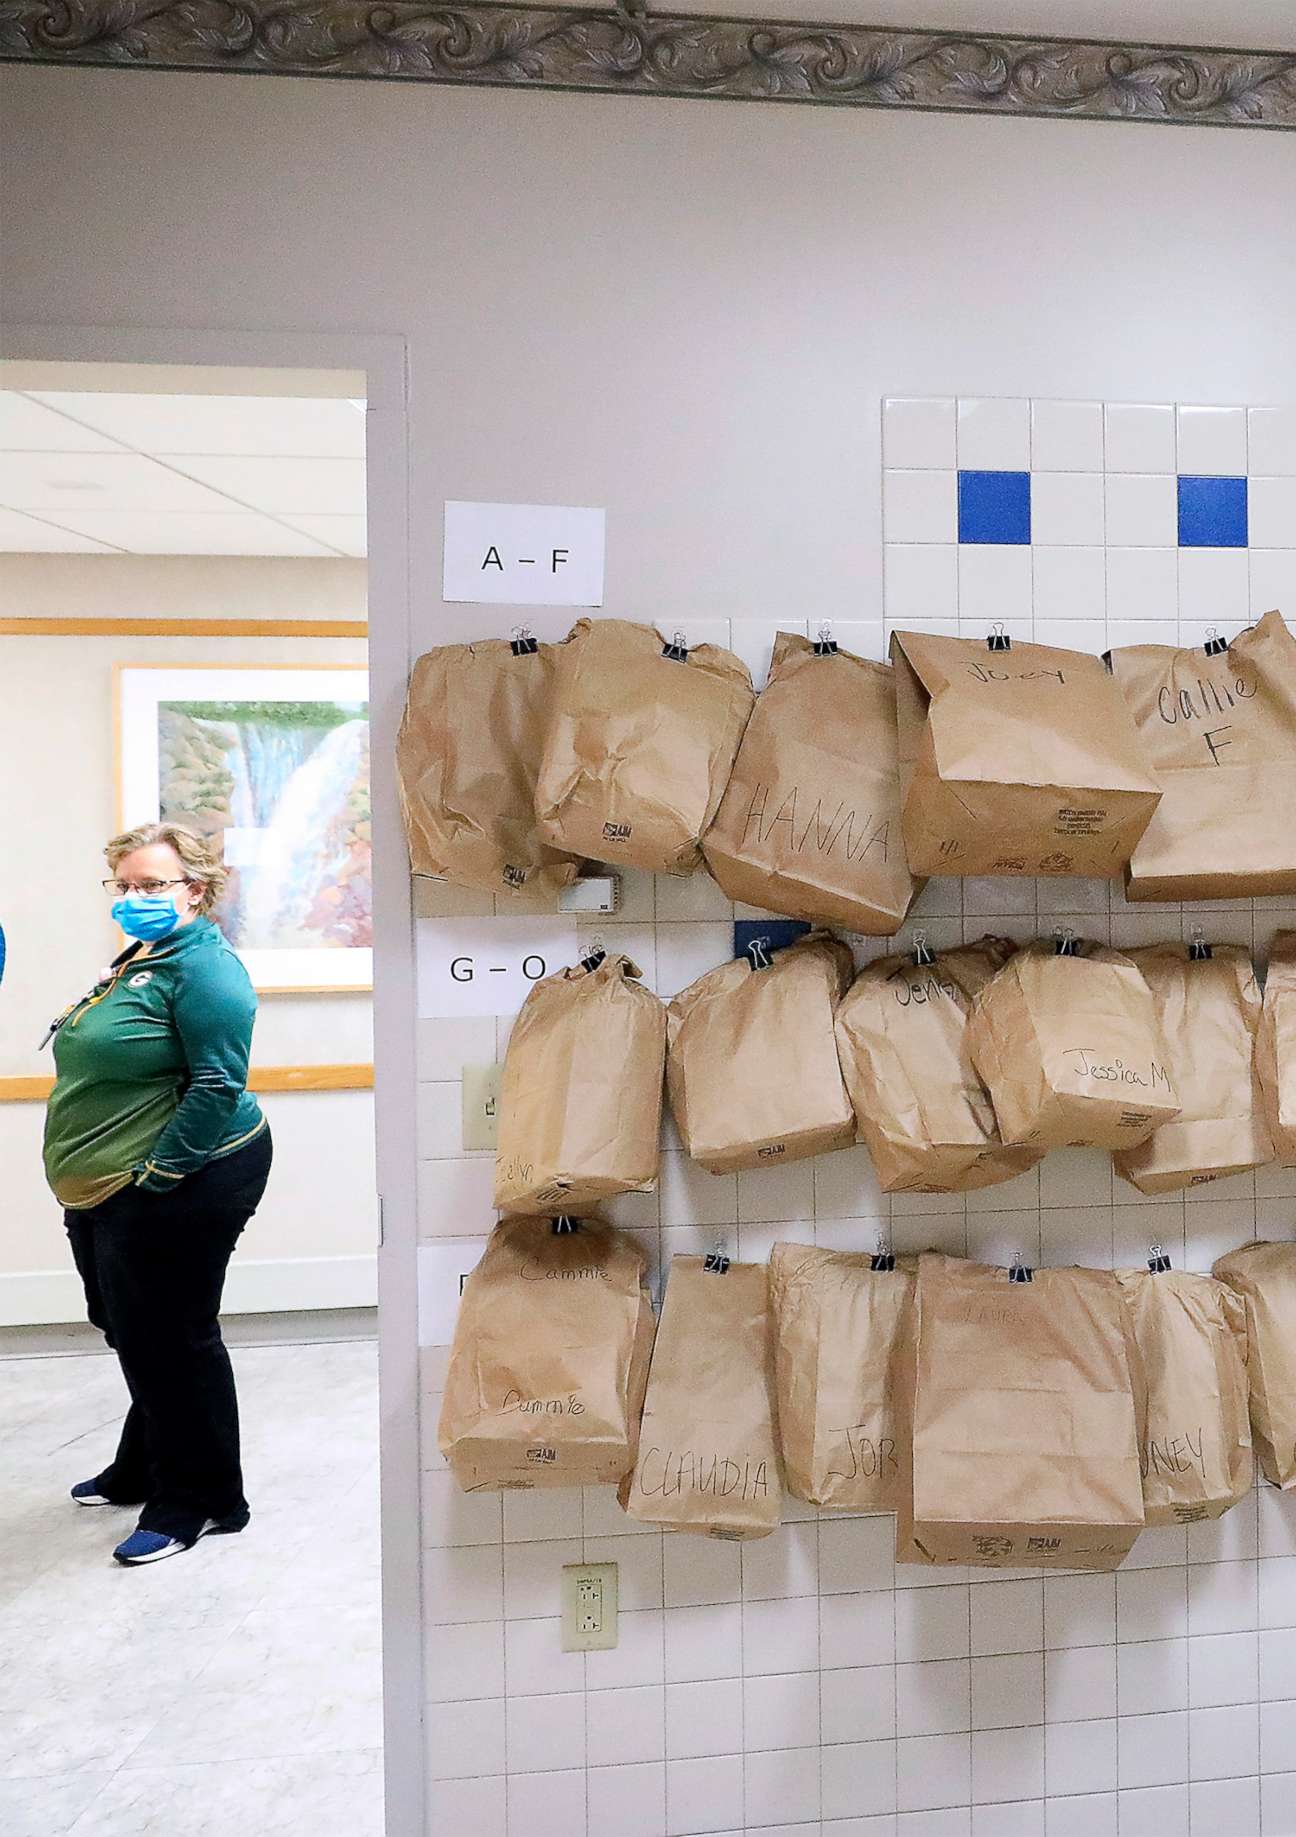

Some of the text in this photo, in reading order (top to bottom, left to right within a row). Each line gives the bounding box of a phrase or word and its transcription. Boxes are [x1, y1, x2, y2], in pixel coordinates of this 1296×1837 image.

[481, 545, 504, 571] A
[551, 548, 570, 573] F
[1157, 678, 1259, 724] Callie
[1202, 725, 1233, 767] F
[741, 782, 890, 863] HANNA
[449, 956, 474, 983] G
[521, 954, 547, 981] O
[1061, 1046, 1173, 1094] Jessica M
[640, 1447, 768, 1500] CLAUDIA
